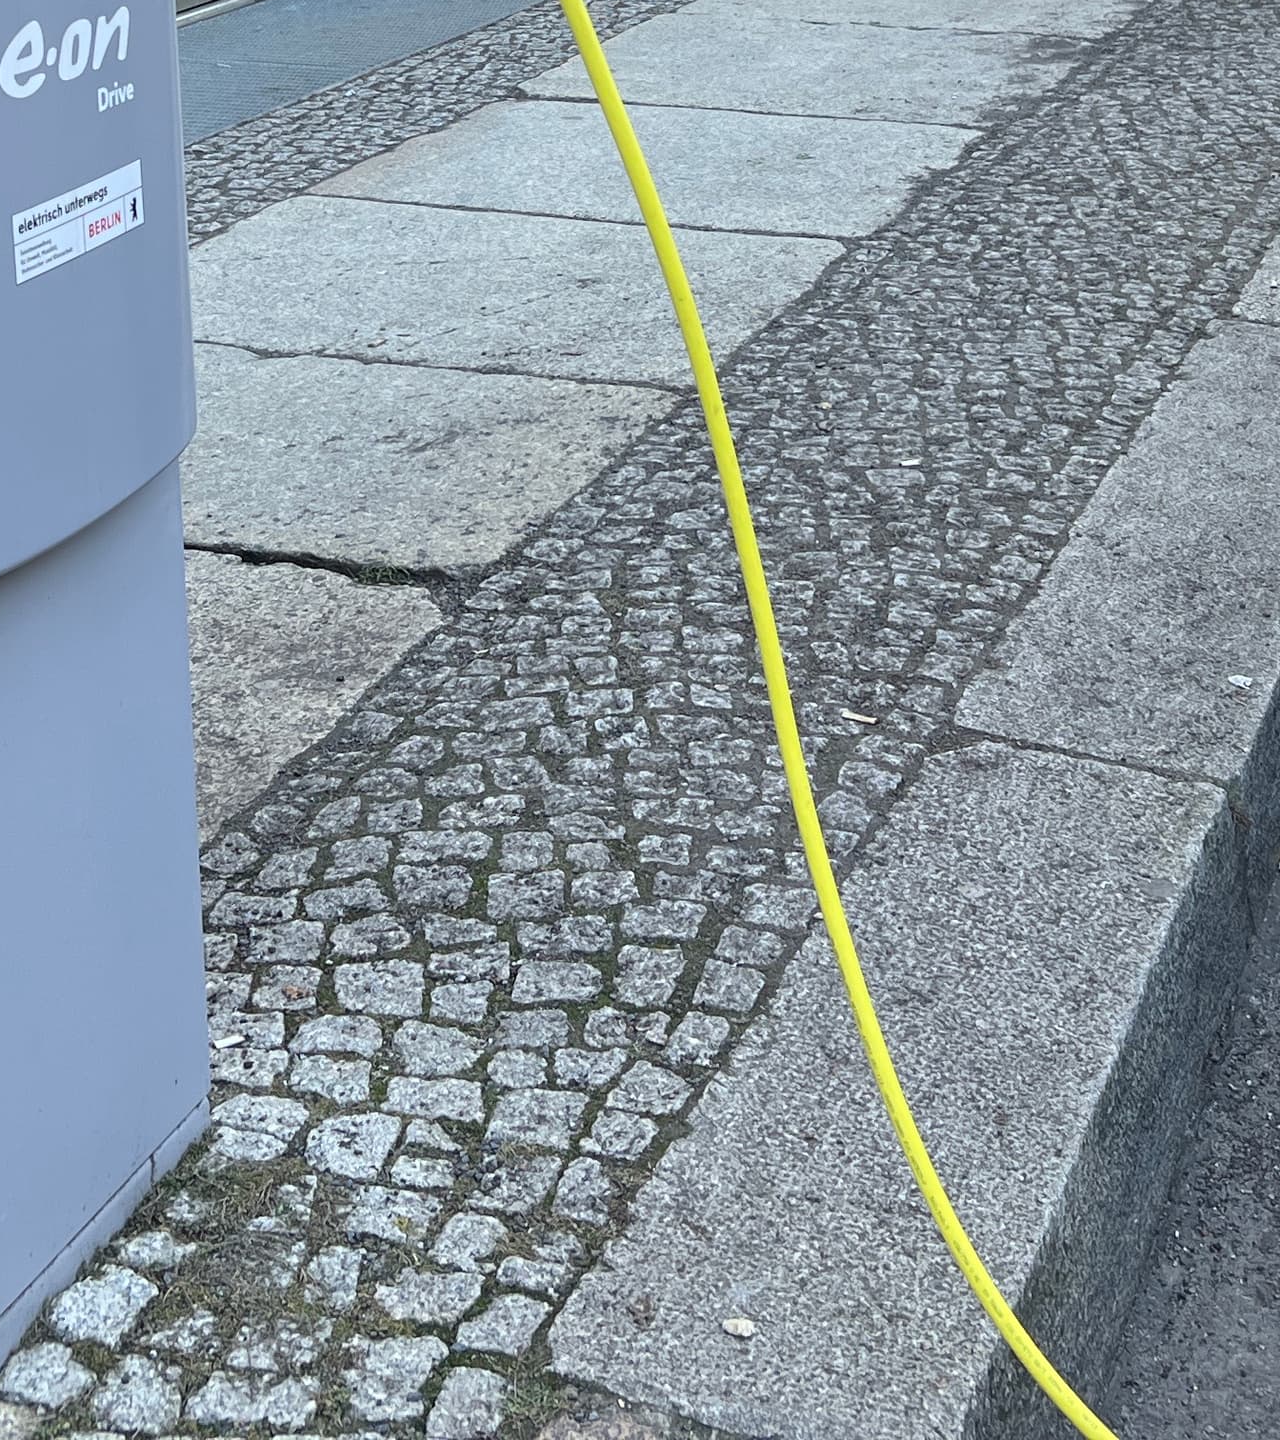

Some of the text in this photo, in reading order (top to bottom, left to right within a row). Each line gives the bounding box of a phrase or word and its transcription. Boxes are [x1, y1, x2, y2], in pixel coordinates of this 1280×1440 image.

[97, 81, 135, 112] Drive
[18, 186, 108, 234] elektrisch unterwegs
[87, 210, 122, 238] BERLIN
